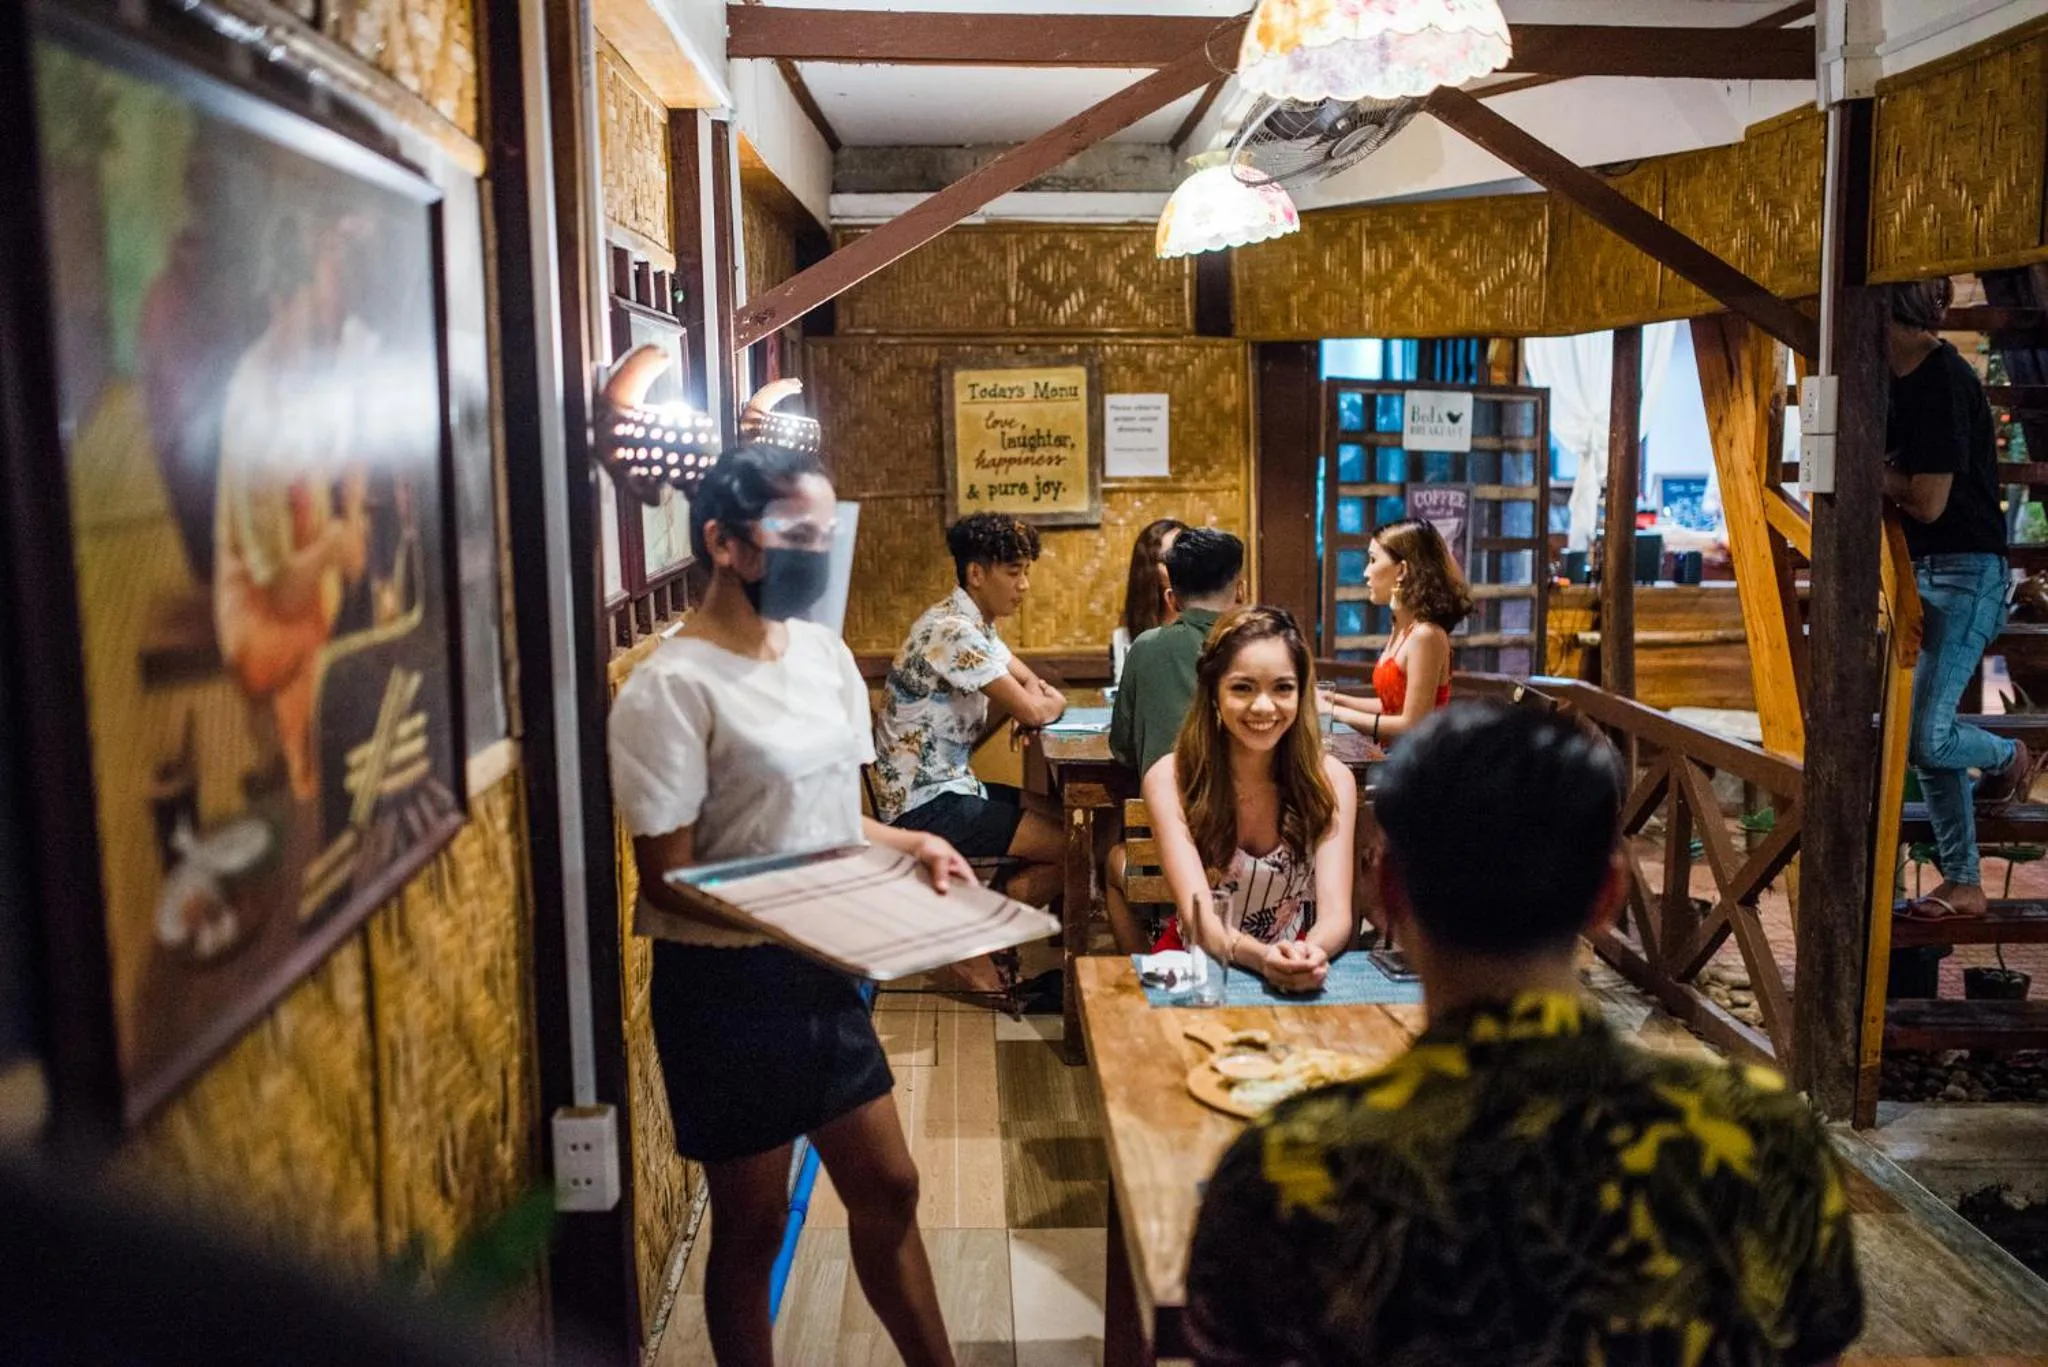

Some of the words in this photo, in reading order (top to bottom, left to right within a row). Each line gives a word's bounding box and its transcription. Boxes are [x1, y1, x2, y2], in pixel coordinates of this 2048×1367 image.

[1033, 381, 1080, 399] Menu
[984, 411, 1027, 430] love,
[1411, 404, 1434, 423] Bed
[1000, 429, 1077, 452] laughter,
[974, 449, 1067, 475] happiness
[966, 485, 980, 501] &
[988, 479, 1029, 501] pure
[1033, 475, 1067, 502] joy.
[1414, 488, 1466, 509] COFFEE
